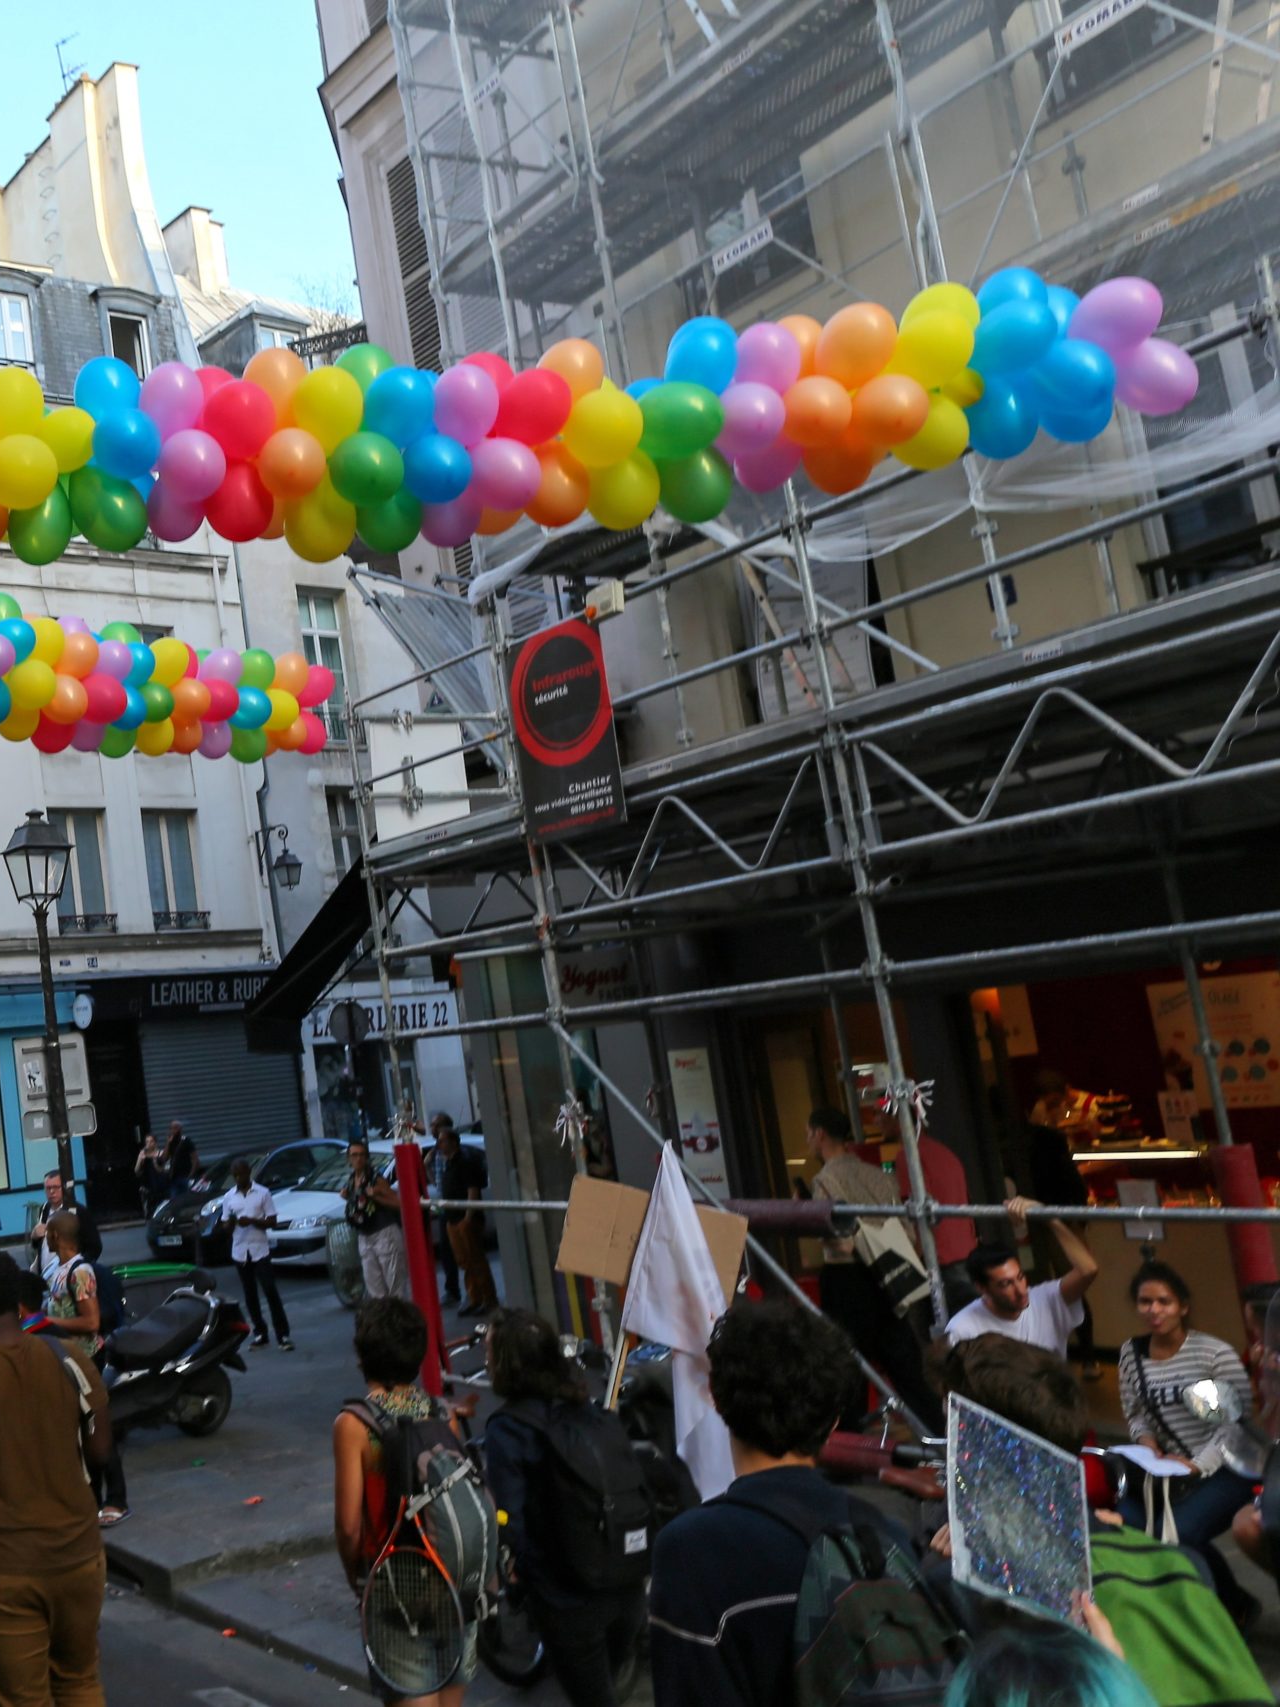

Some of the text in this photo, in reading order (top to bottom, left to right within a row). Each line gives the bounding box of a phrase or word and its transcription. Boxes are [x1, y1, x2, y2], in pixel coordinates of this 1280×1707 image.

[568, 775, 611, 794] Chantier
[151, 980, 214, 1007] LEATHER
[218, 981, 228, 1002] &
[432, 1001, 449, 1026] 22
